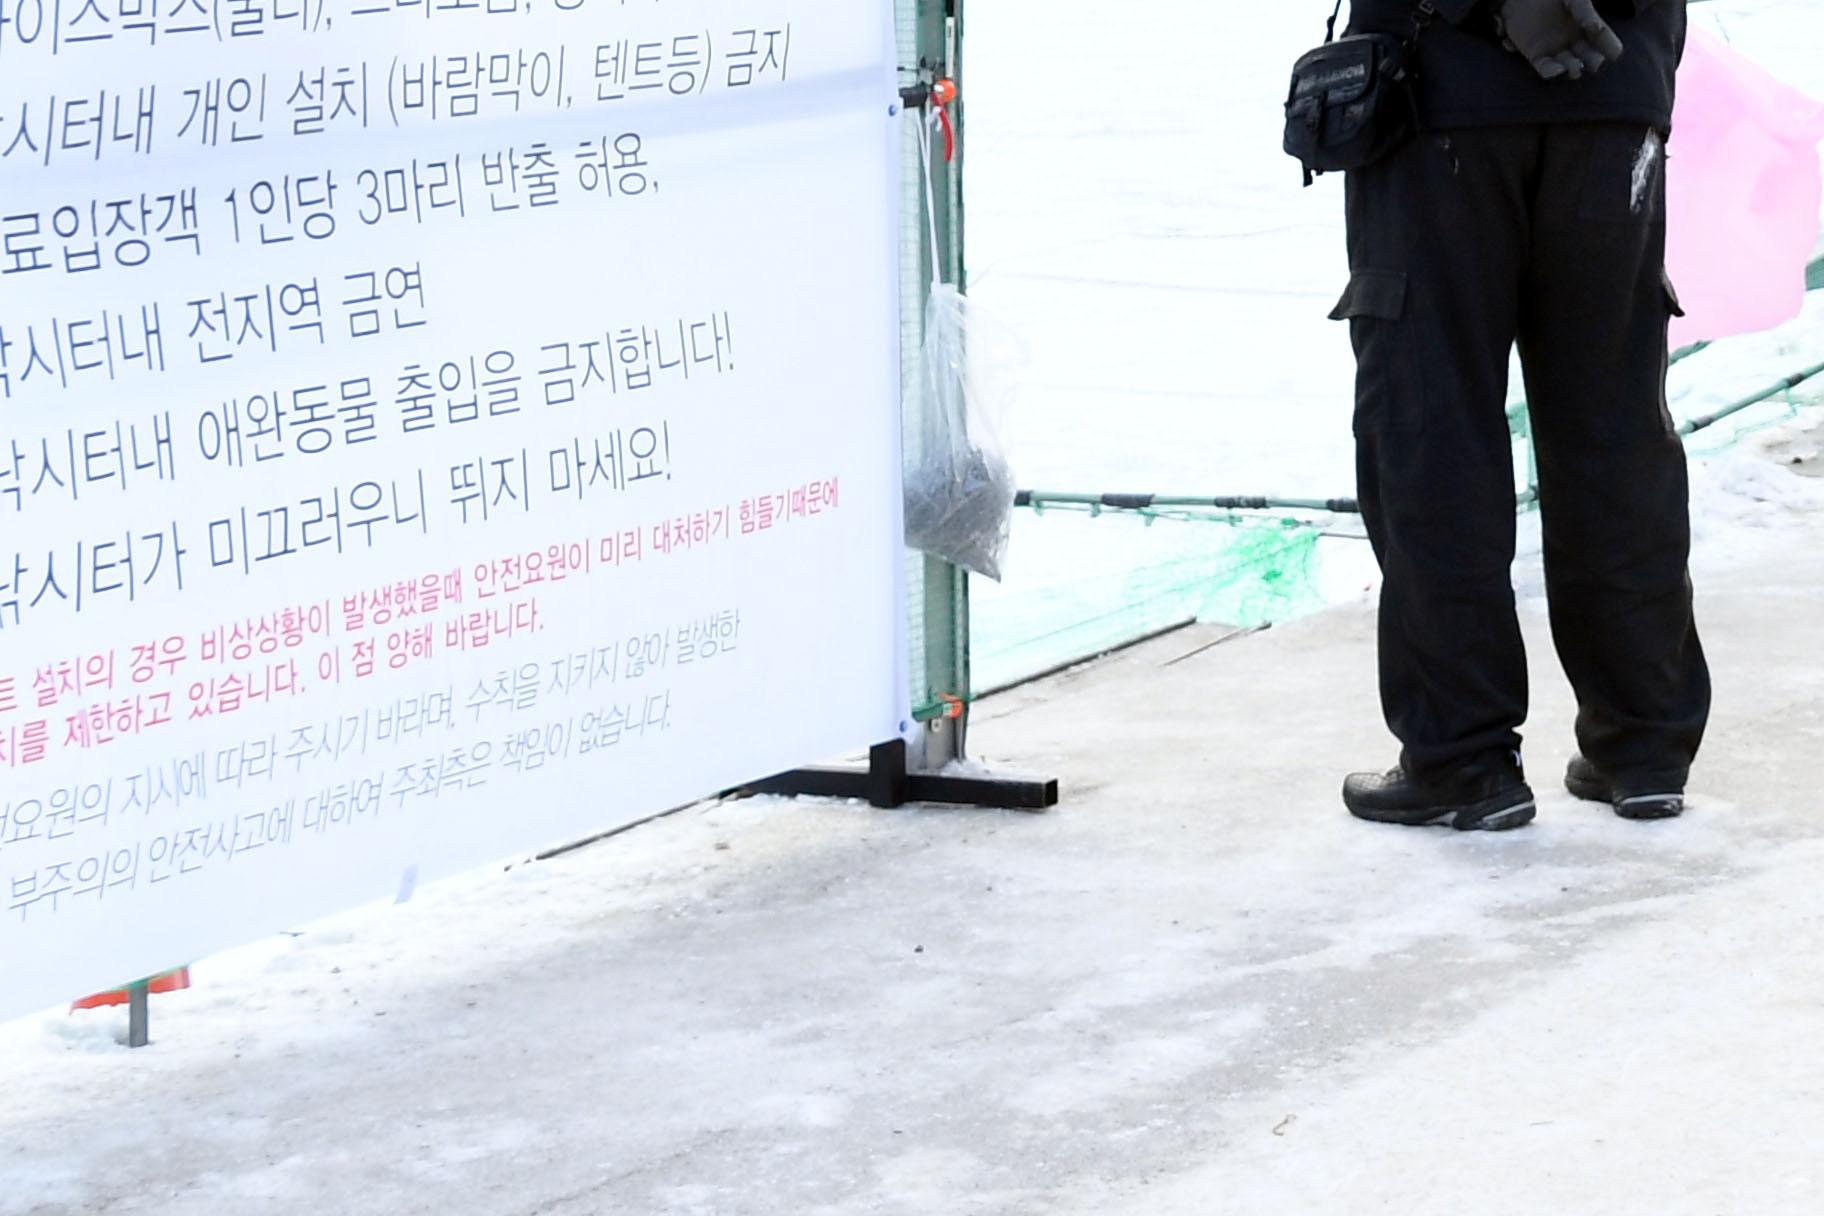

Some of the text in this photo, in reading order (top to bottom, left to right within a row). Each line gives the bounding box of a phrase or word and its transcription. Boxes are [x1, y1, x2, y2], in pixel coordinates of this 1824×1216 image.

[177, 72, 266, 147] 개인
[286, 61, 369, 129] 설치
[594, 29, 713, 104] 텐트등)
[725, 22, 791, 87] 금지
[223, 169, 338, 245] 1인당
[357, 152, 466, 225] 3마리
[481, 142, 560, 212] 반출
[186, 276, 325, 364] 전지역
[341, 261, 428, 331] 금연
[198, 375, 379, 468] 애완동물
[394, 347, 523, 433] 출입을
[537, 310, 735, 405] 금지합니다!
[208, 471, 428, 576] 미끄러우니
[450, 448, 529, 527] 뛰지
[549, 420, 672, 500] 마세요!
[32, 649, 114, 709] 설치의
[130, 635, 187, 683] 경우
[201, 599, 331, 664] 비상상황이
[343, 568, 463, 633] 발생했을때
[474, 538, 589, 599] 안전요원이
[600, 526, 641, 567] 미리
[653, 504, 729, 554] 대처하기
[64, 691, 172, 748] 제한하고
[188, 658, 306, 720] 있습니다.
[318, 646, 340, 684] 이
[352, 637, 375, 678] 점
[387, 622, 433, 669] 양해
[445, 597, 544, 652] 바랍니다.
[120, 751, 206, 815] 지시에
[216, 733, 278, 788] 따라
[285, 708, 368, 773] 주시기
[465, 662, 541, 722] 수칙을
[547, 640, 619, 695] 지키지
[625, 626, 670, 679] 않아
[677, 608, 741, 664] 발생한
[8, 842, 140, 922] 부주의의
[149, 799, 294, 883] 안전사고에
[303, 771, 384, 834] 대하여
[390, 734, 492, 808] 주최측은
[500, 718, 573, 772] 책임이
